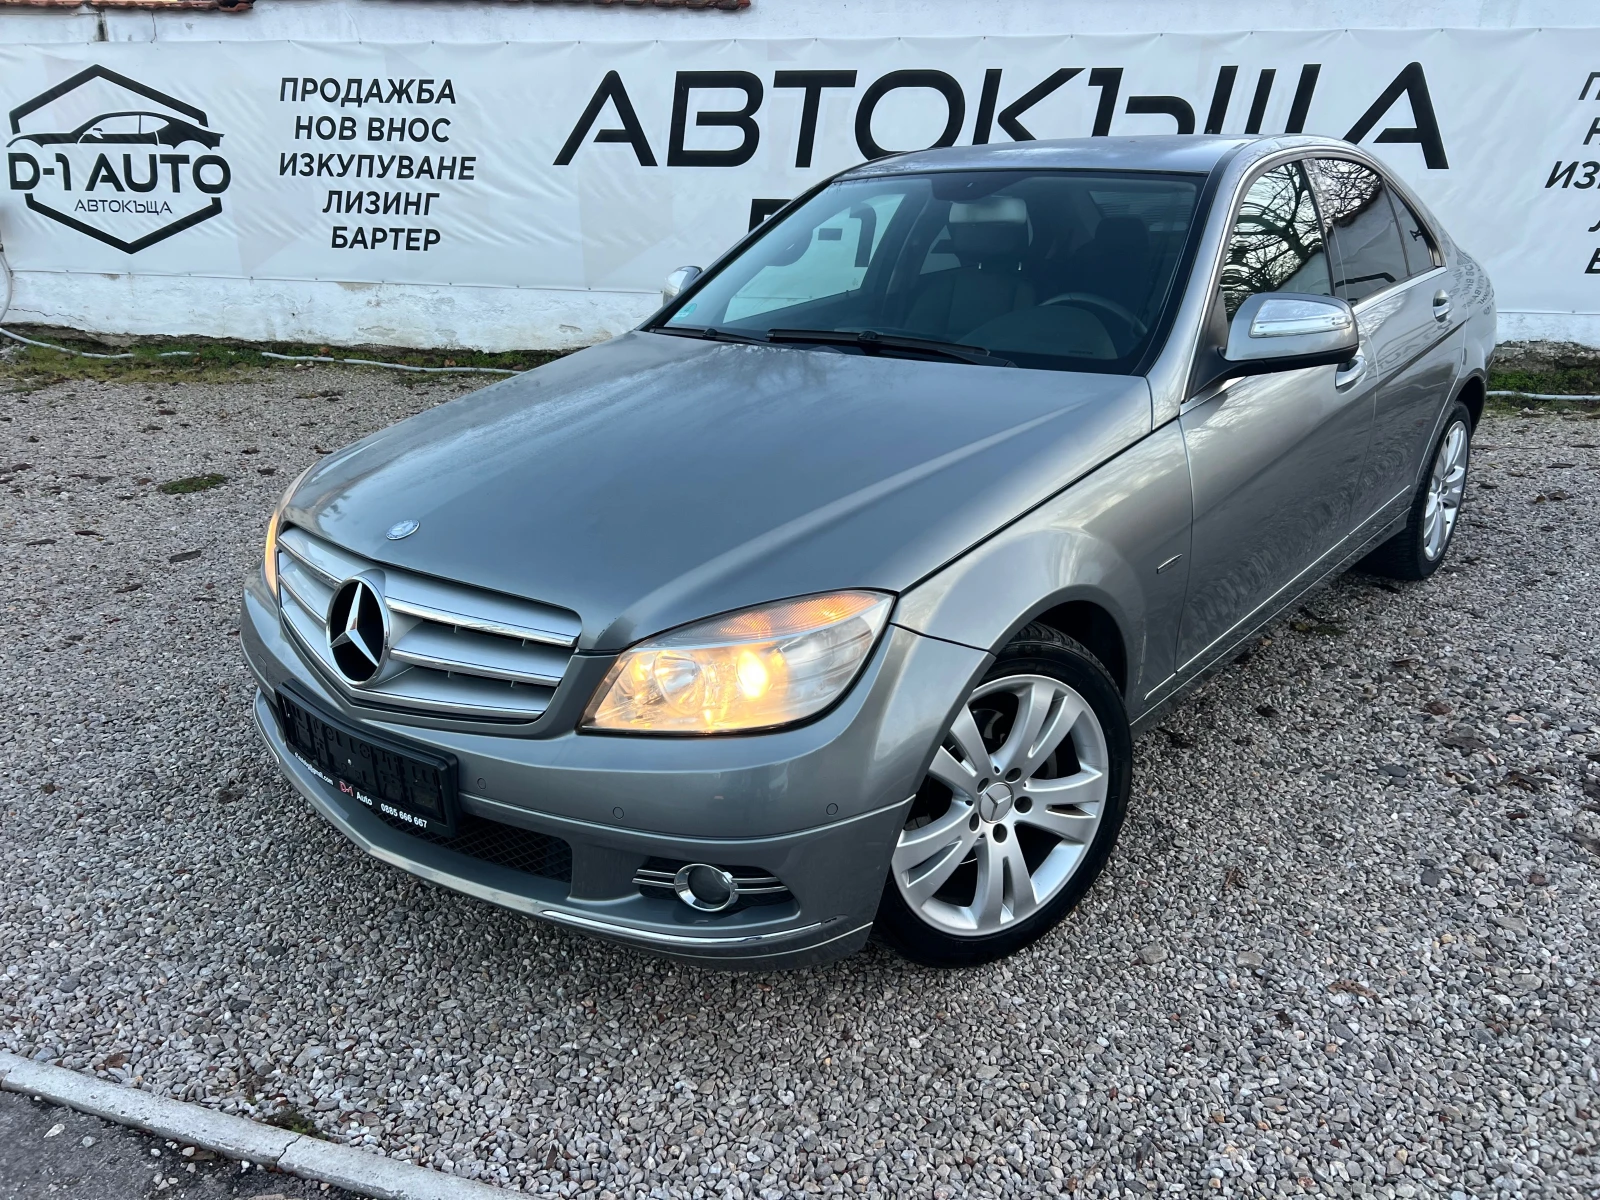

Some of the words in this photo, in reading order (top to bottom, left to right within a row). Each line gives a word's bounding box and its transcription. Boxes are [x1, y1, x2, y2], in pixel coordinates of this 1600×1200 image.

[280, 78, 456, 107] ПРОДАЖБА
[294, 115, 357, 141] НОВ
[367, 117, 451, 143] ВНОС
[8, 152, 72, 191] D-1
[85, 152, 232, 194] AUTO
[279, 152, 477, 181] ИЗКУПУВАНЕ
[73, 199, 173, 216] АВТОКЪЩА
[322, 191, 440, 216] ЛИЗИНГ
[331, 226, 441, 252] БАРТЕР
[356, 791, 373, 806] Auto
[380, 803, 399, 817] 0885
[398, 810, 413, 823] 666
[413, 816, 428, 829] 667
